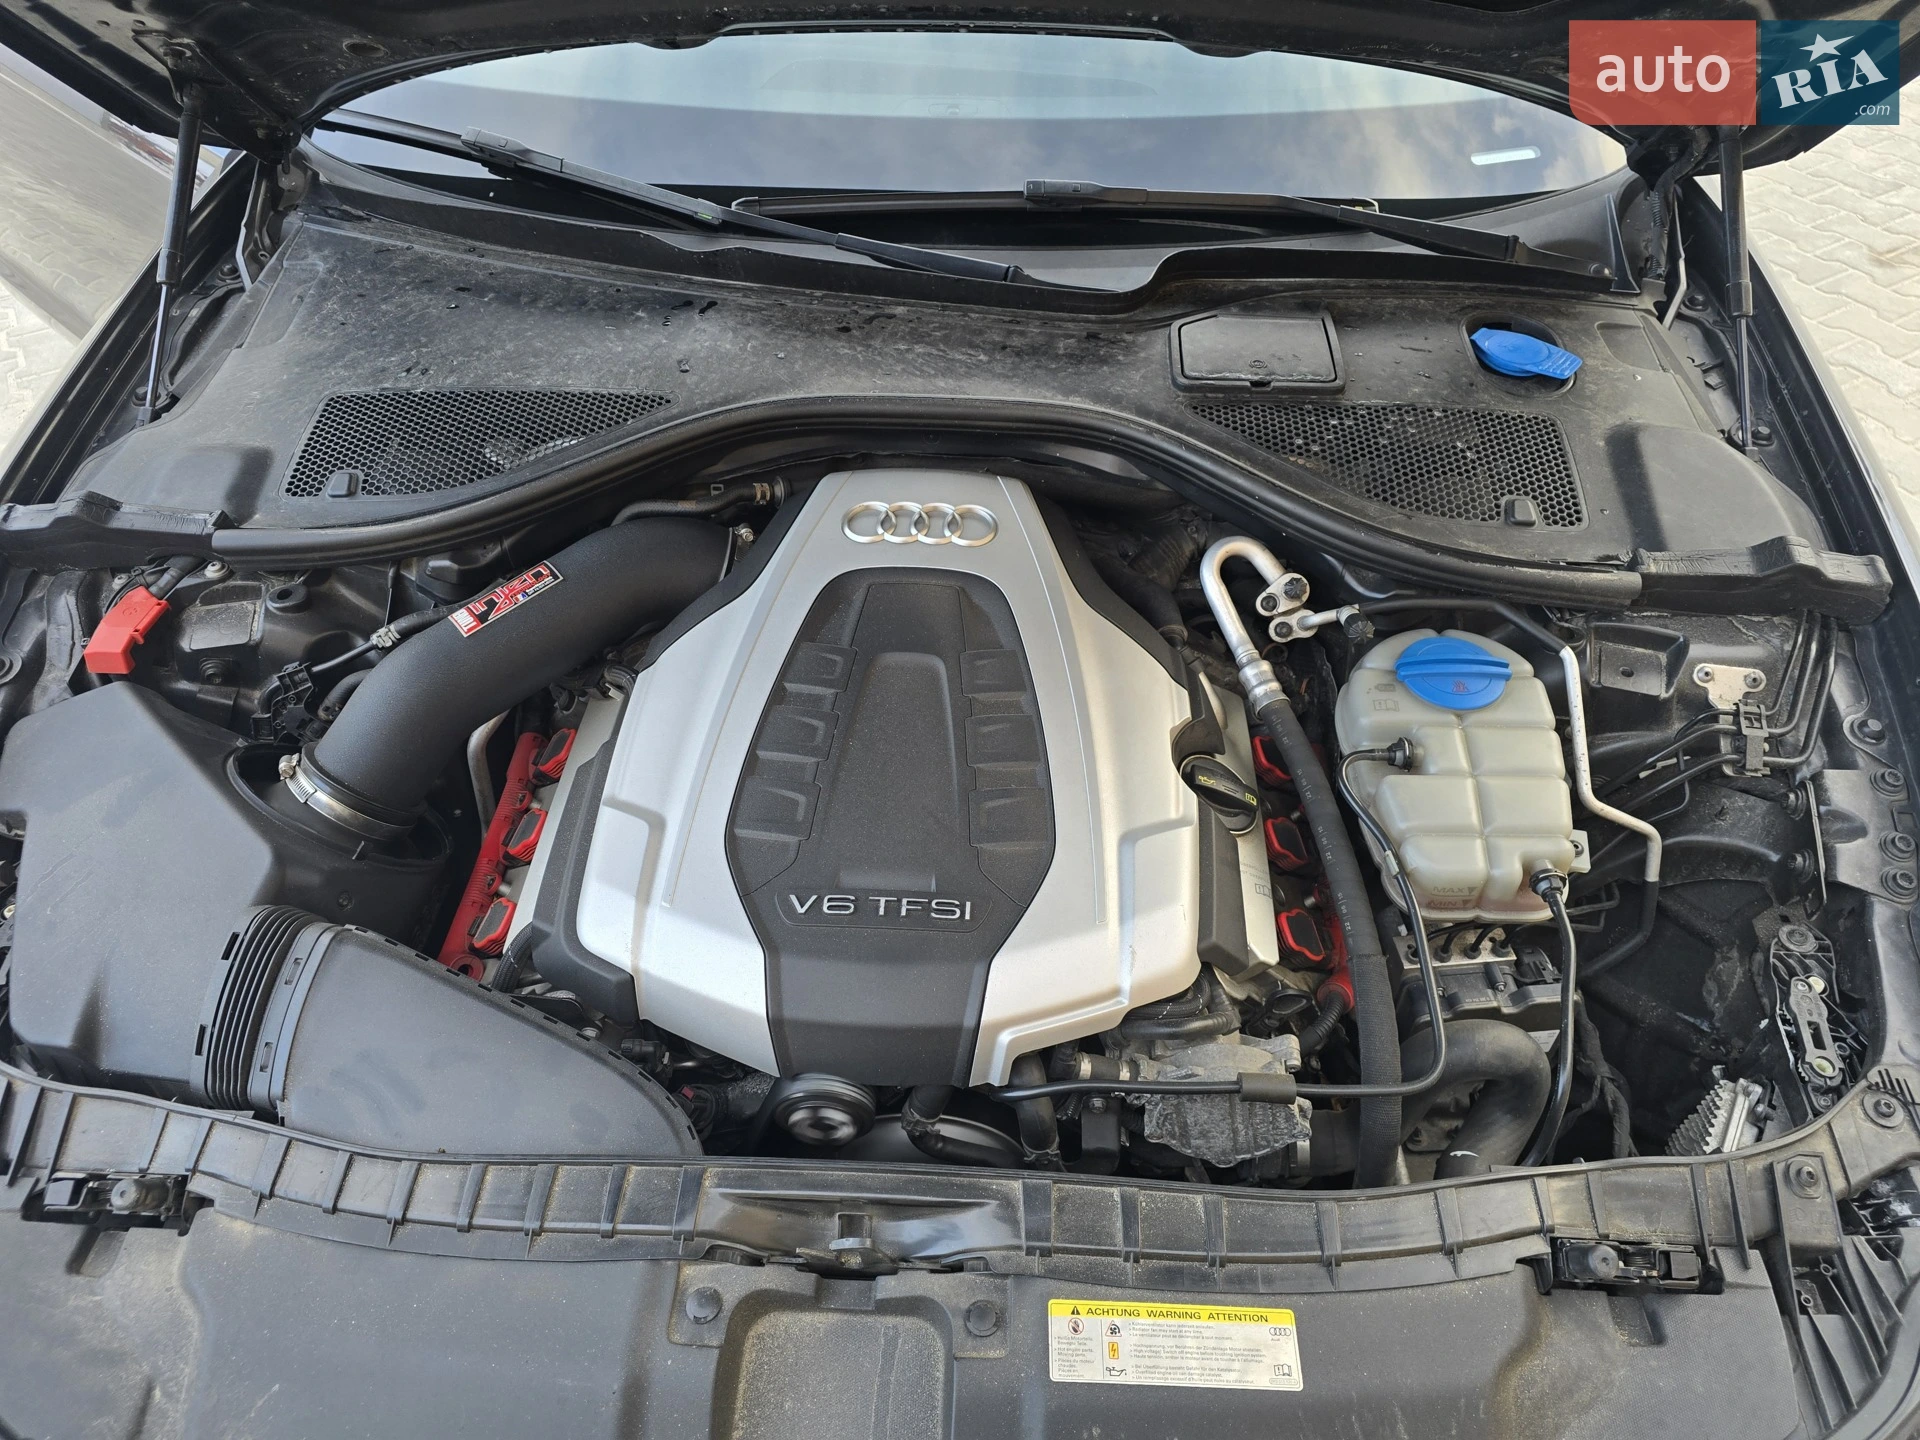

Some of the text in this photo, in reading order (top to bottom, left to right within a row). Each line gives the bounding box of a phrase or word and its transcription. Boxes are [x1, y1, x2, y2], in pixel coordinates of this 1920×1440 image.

[789, 894, 972, 920] V6 TFSI
[1085, 1307, 1268, 1322] ACHTUNG WARNING ATTENTION
